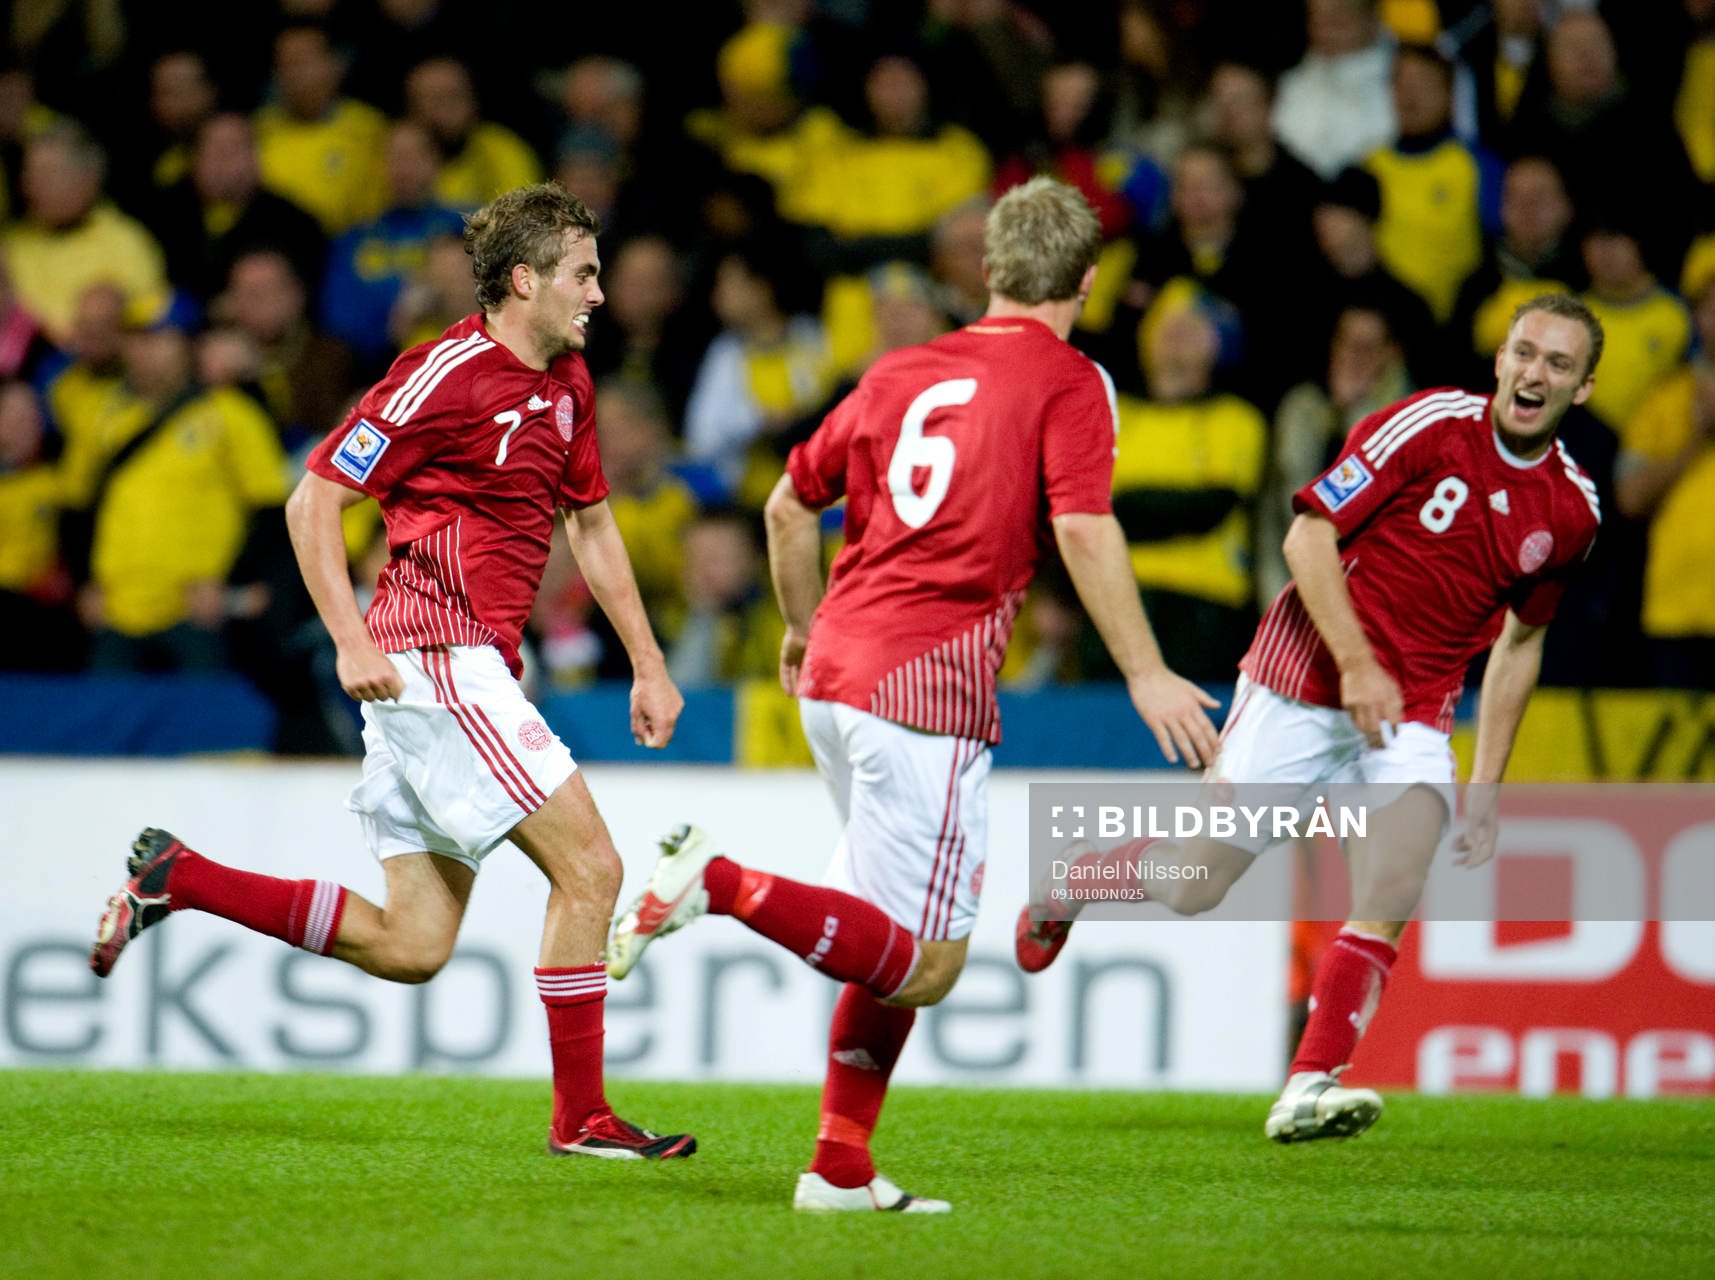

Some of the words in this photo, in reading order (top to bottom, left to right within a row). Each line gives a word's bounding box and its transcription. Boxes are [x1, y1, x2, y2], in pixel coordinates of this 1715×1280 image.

[493, 409, 522, 467] 7
[887, 377, 978, 529] 6
[1419, 476, 1469, 534] 8
[1420, 816, 1715, 985] D
[4, 922, 1180, 1076] eksperen
